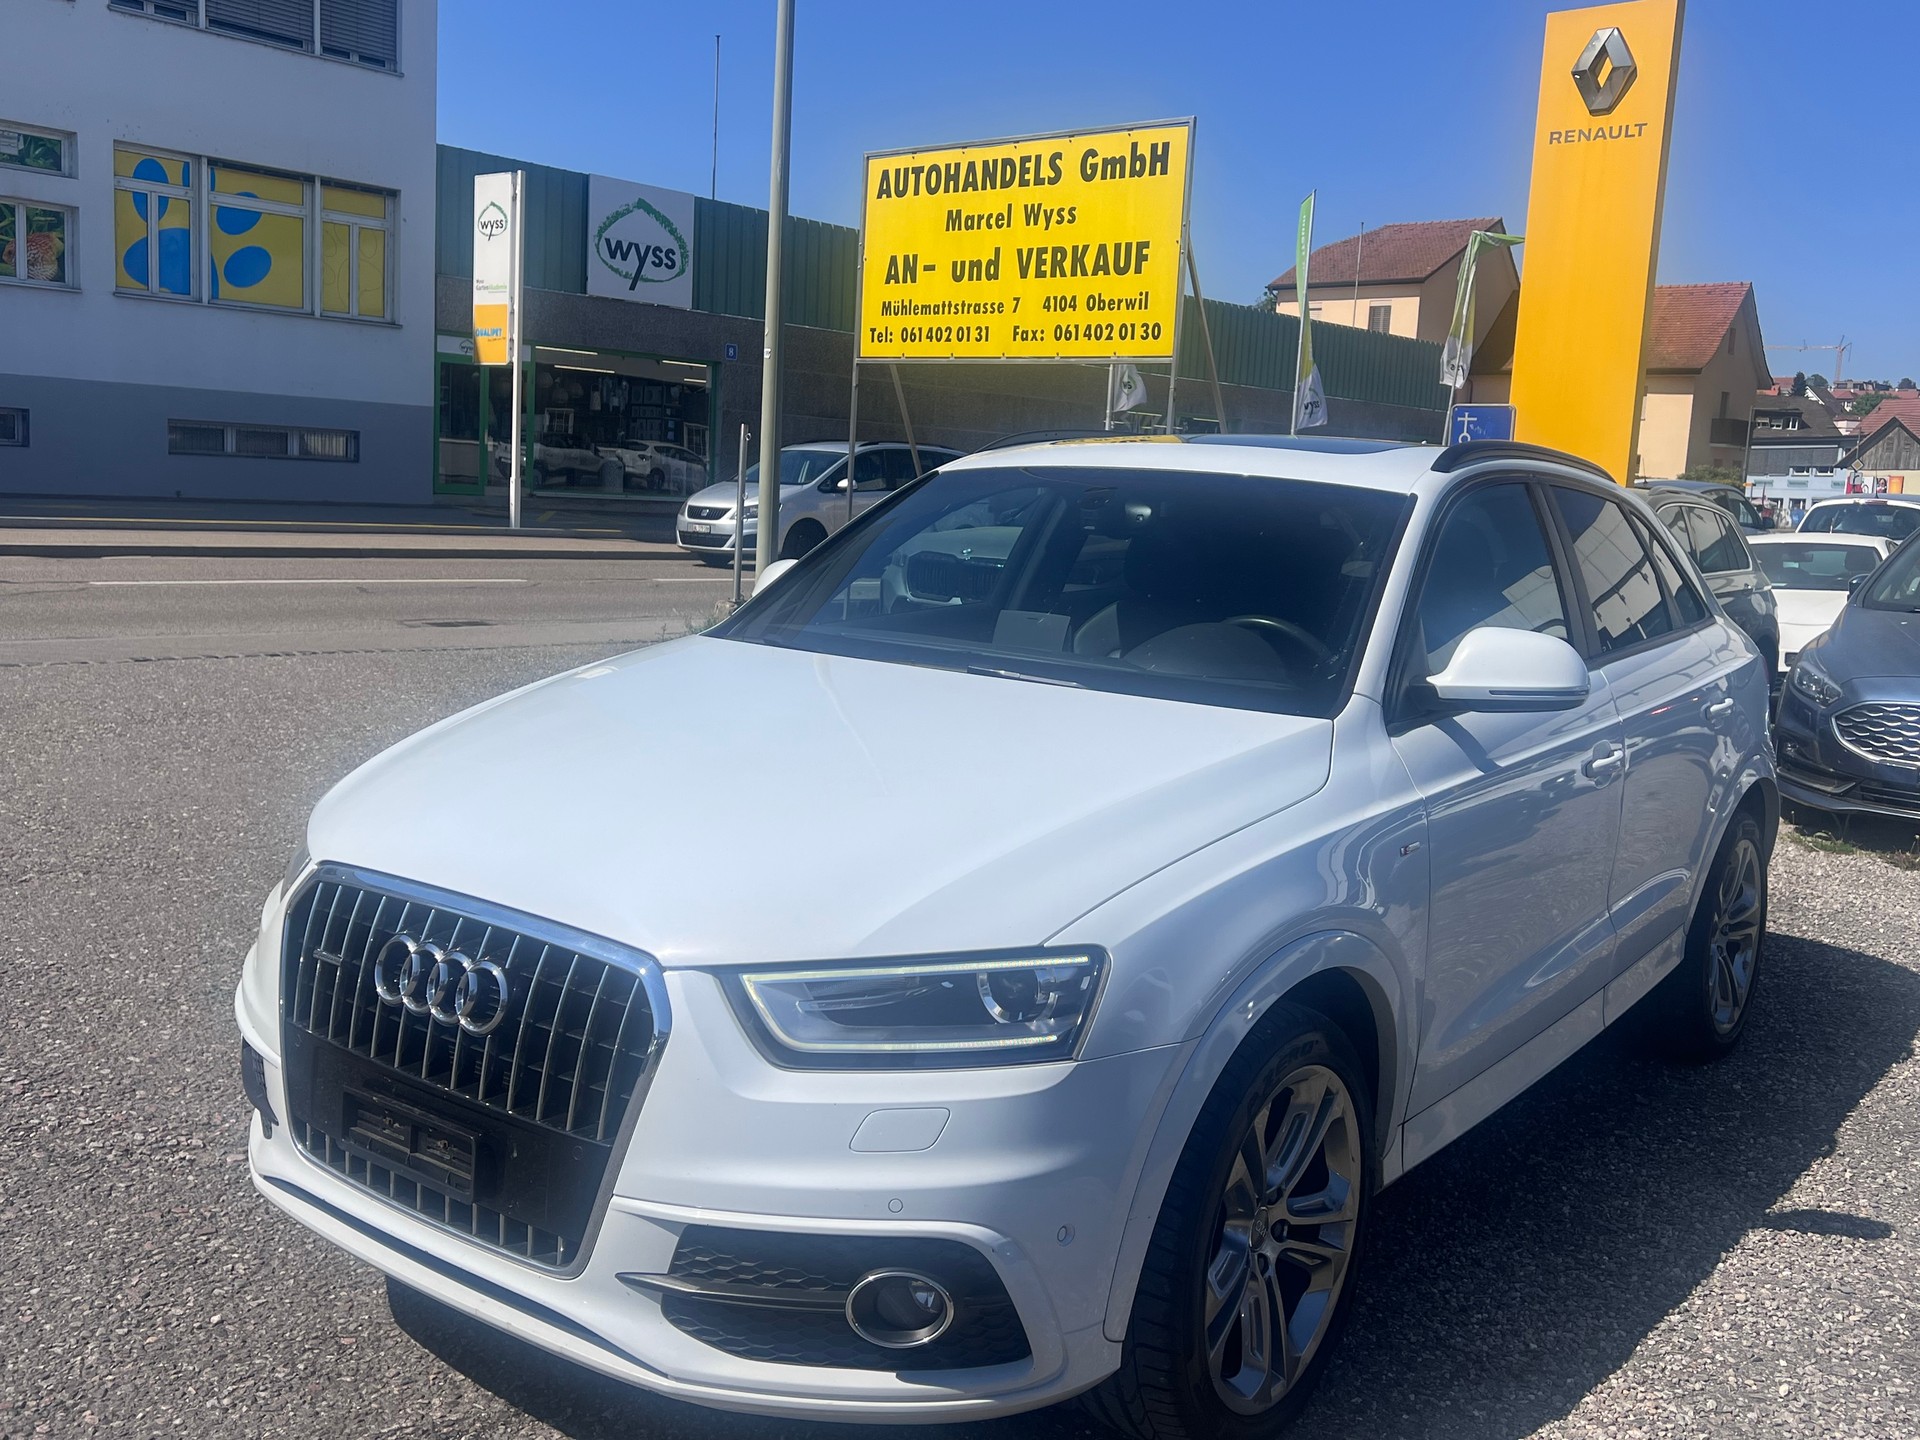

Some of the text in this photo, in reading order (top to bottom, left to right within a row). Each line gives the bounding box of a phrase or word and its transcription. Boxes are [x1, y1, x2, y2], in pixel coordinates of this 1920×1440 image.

[1549, 123, 1648, 145] RENAULT
[876, 141, 1171, 199] AUTOHANDELS GmbH
[945, 202, 1077, 232] Marcel Wyss
[480, 219, 504, 242] wyss
[604, 237, 677, 291] wyss
[951, 246, 1001, 283] und
[1016, 241, 1150, 279] VERKAUF
[881, 291, 1149, 316] Mühlemattstrasse 7 4104 Oberwil
[869, 326, 894, 343] Tel:
[1012, 325, 1045, 341] Fax:
[728, 347, 734, 357] 8
